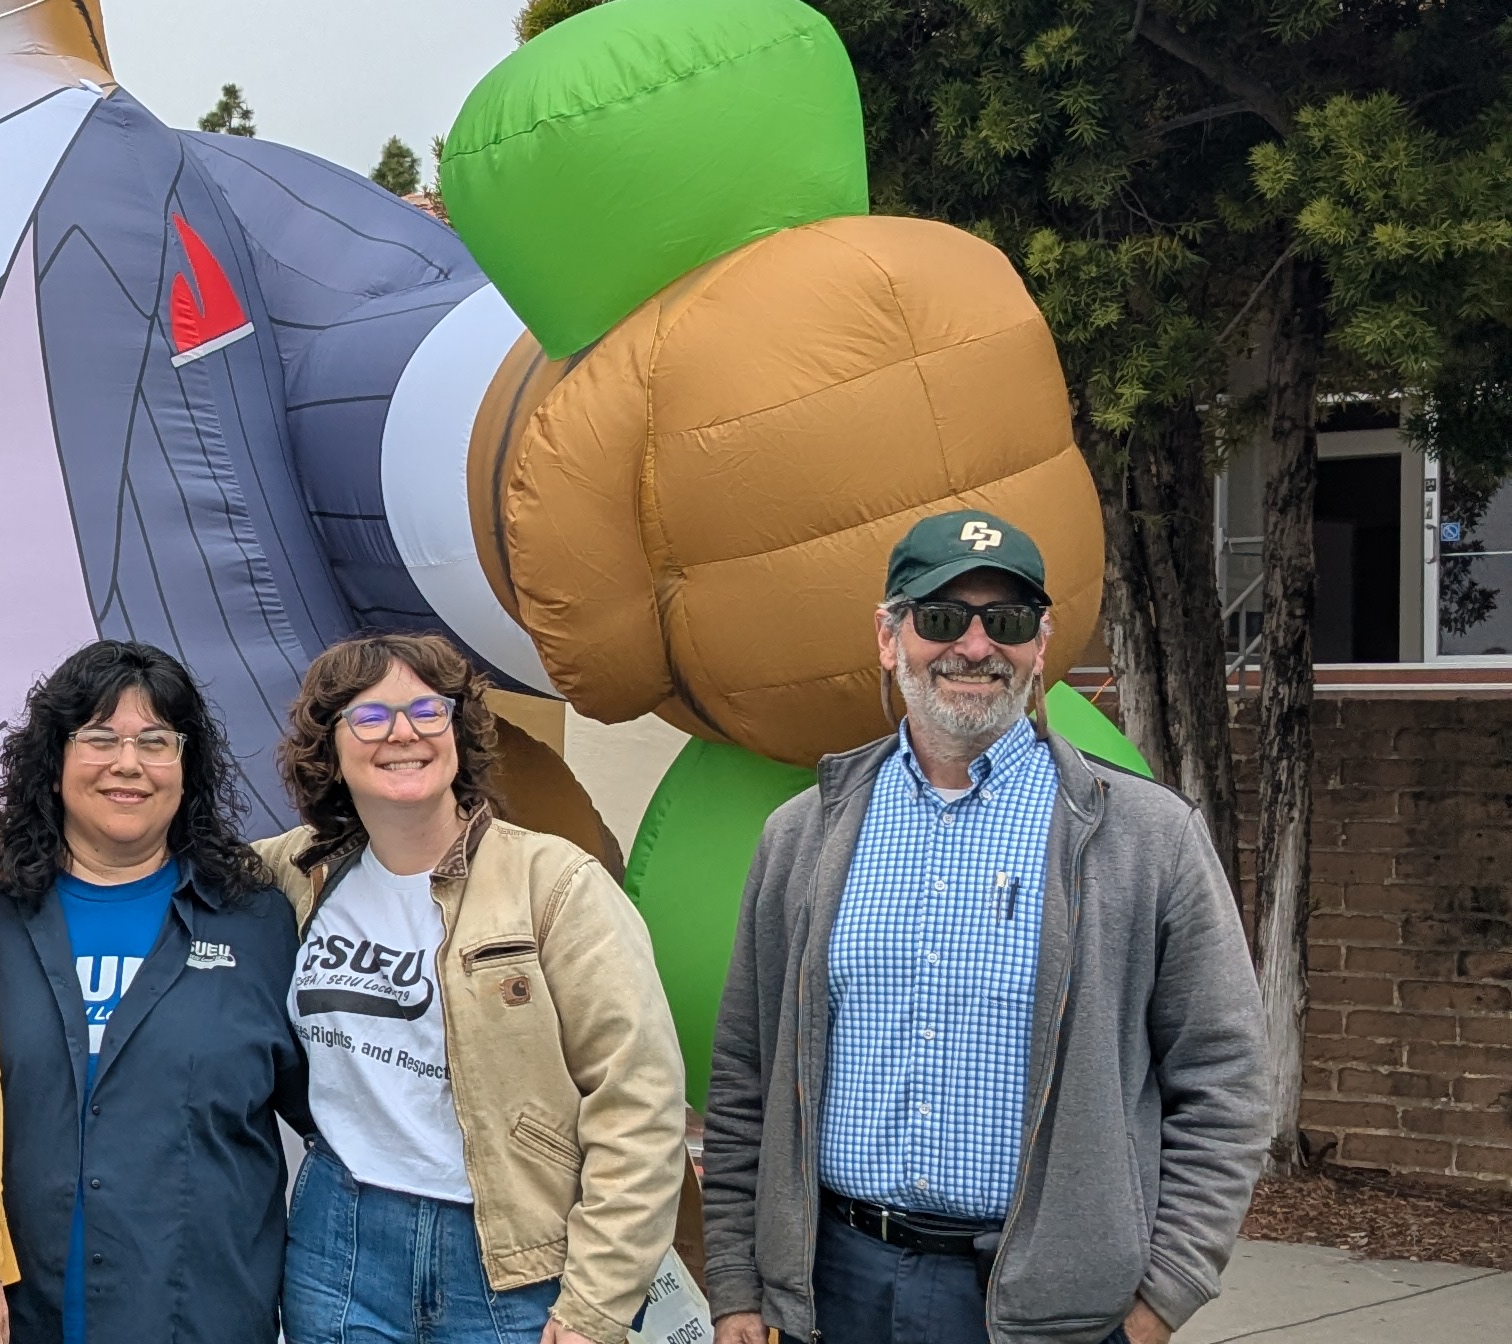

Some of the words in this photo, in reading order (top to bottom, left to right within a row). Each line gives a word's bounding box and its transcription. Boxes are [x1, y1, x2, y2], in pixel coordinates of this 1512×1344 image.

[960, 521, 1003, 551] CP
[191, 941, 231, 956] UEU
[301, 935, 426, 987] CSUEU
[326, 974, 364, 987] SEIU
[363, 979, 393, 996] Loca
[310, 1025, 356, 1053] Rights,
[361, 1042, 393, 1064] and
[396, 1050, 451, 1080] Respect
[656, 1272, 679, 1295] THE
